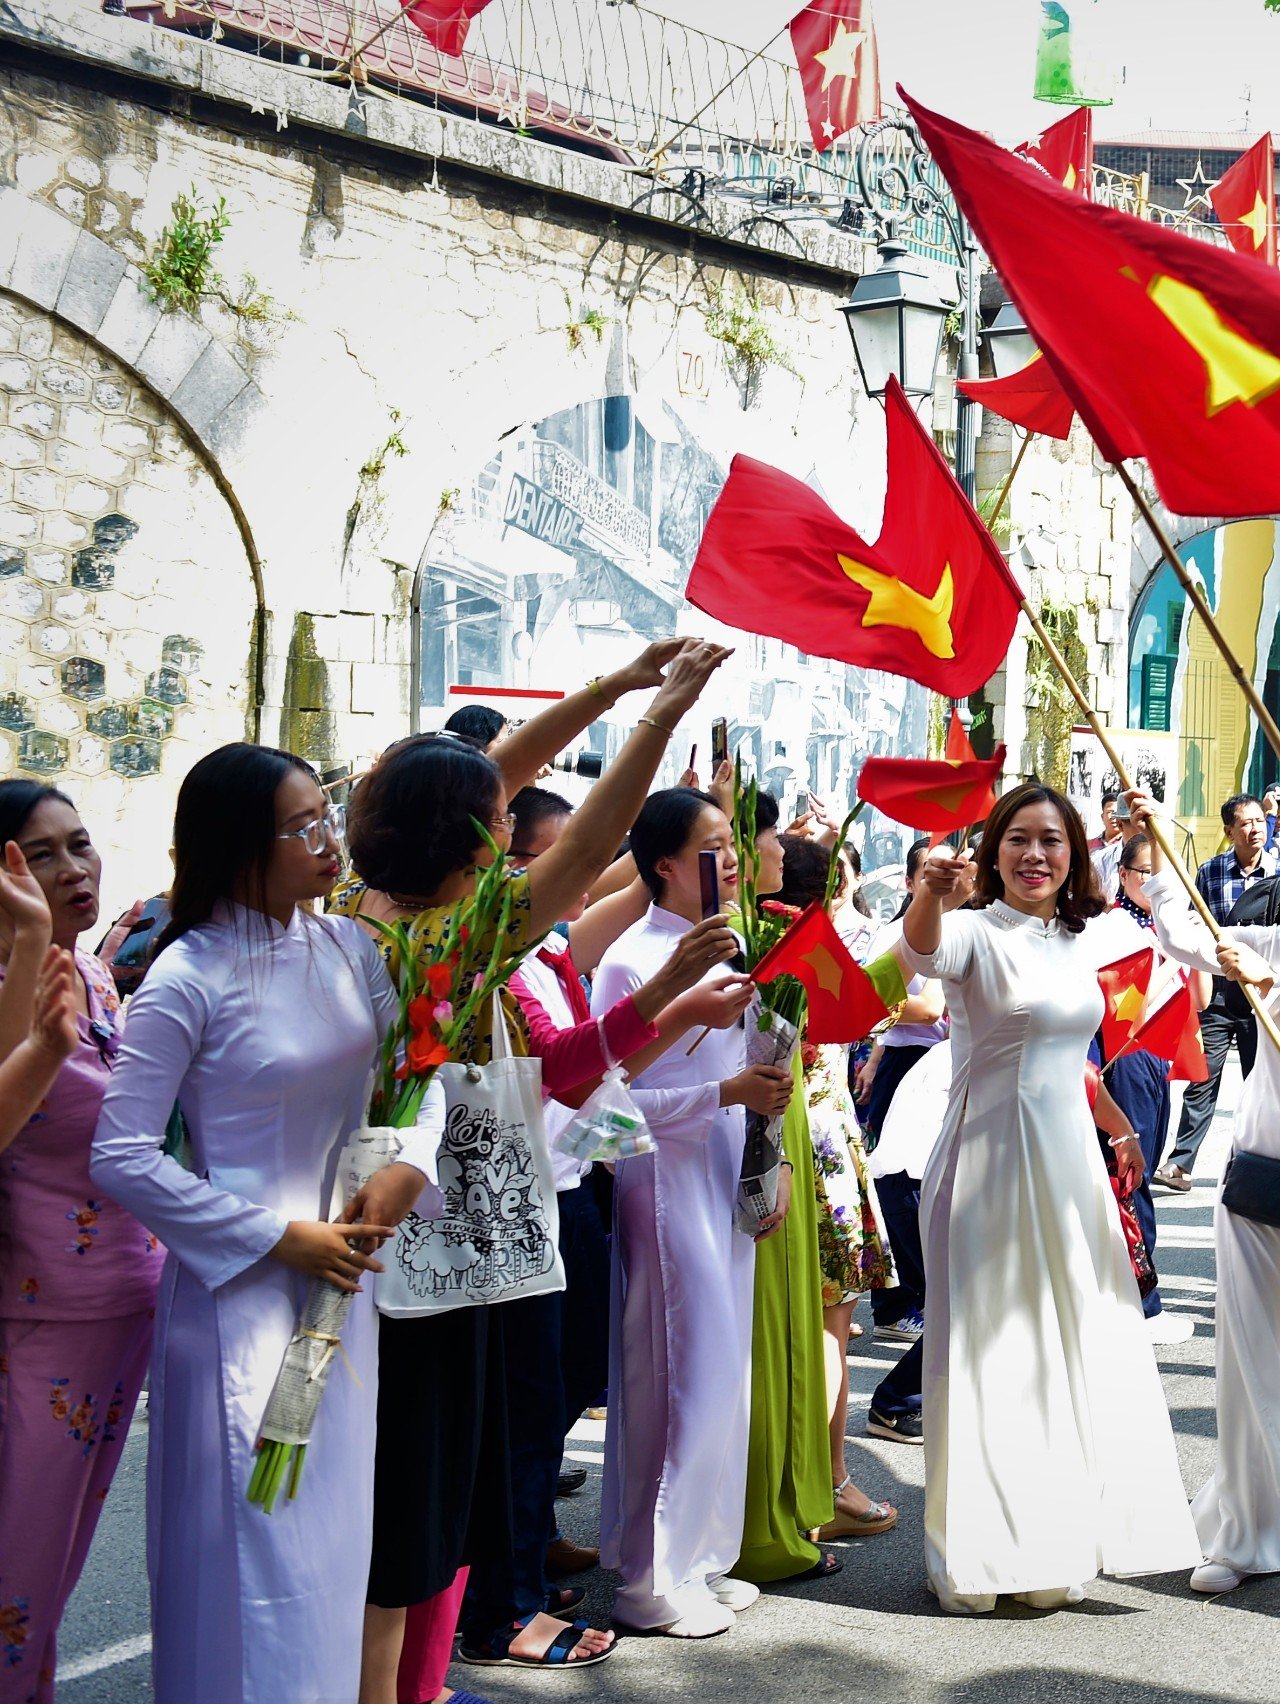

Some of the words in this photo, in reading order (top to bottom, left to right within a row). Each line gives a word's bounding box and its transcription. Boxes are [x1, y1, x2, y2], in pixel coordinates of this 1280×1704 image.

[682, 351, 704, 390] 70
[504, 475, 584, 546] DENTAIRE
[442, 1221, 492, 1239] around
[498, 1227, 517, 1240] the
